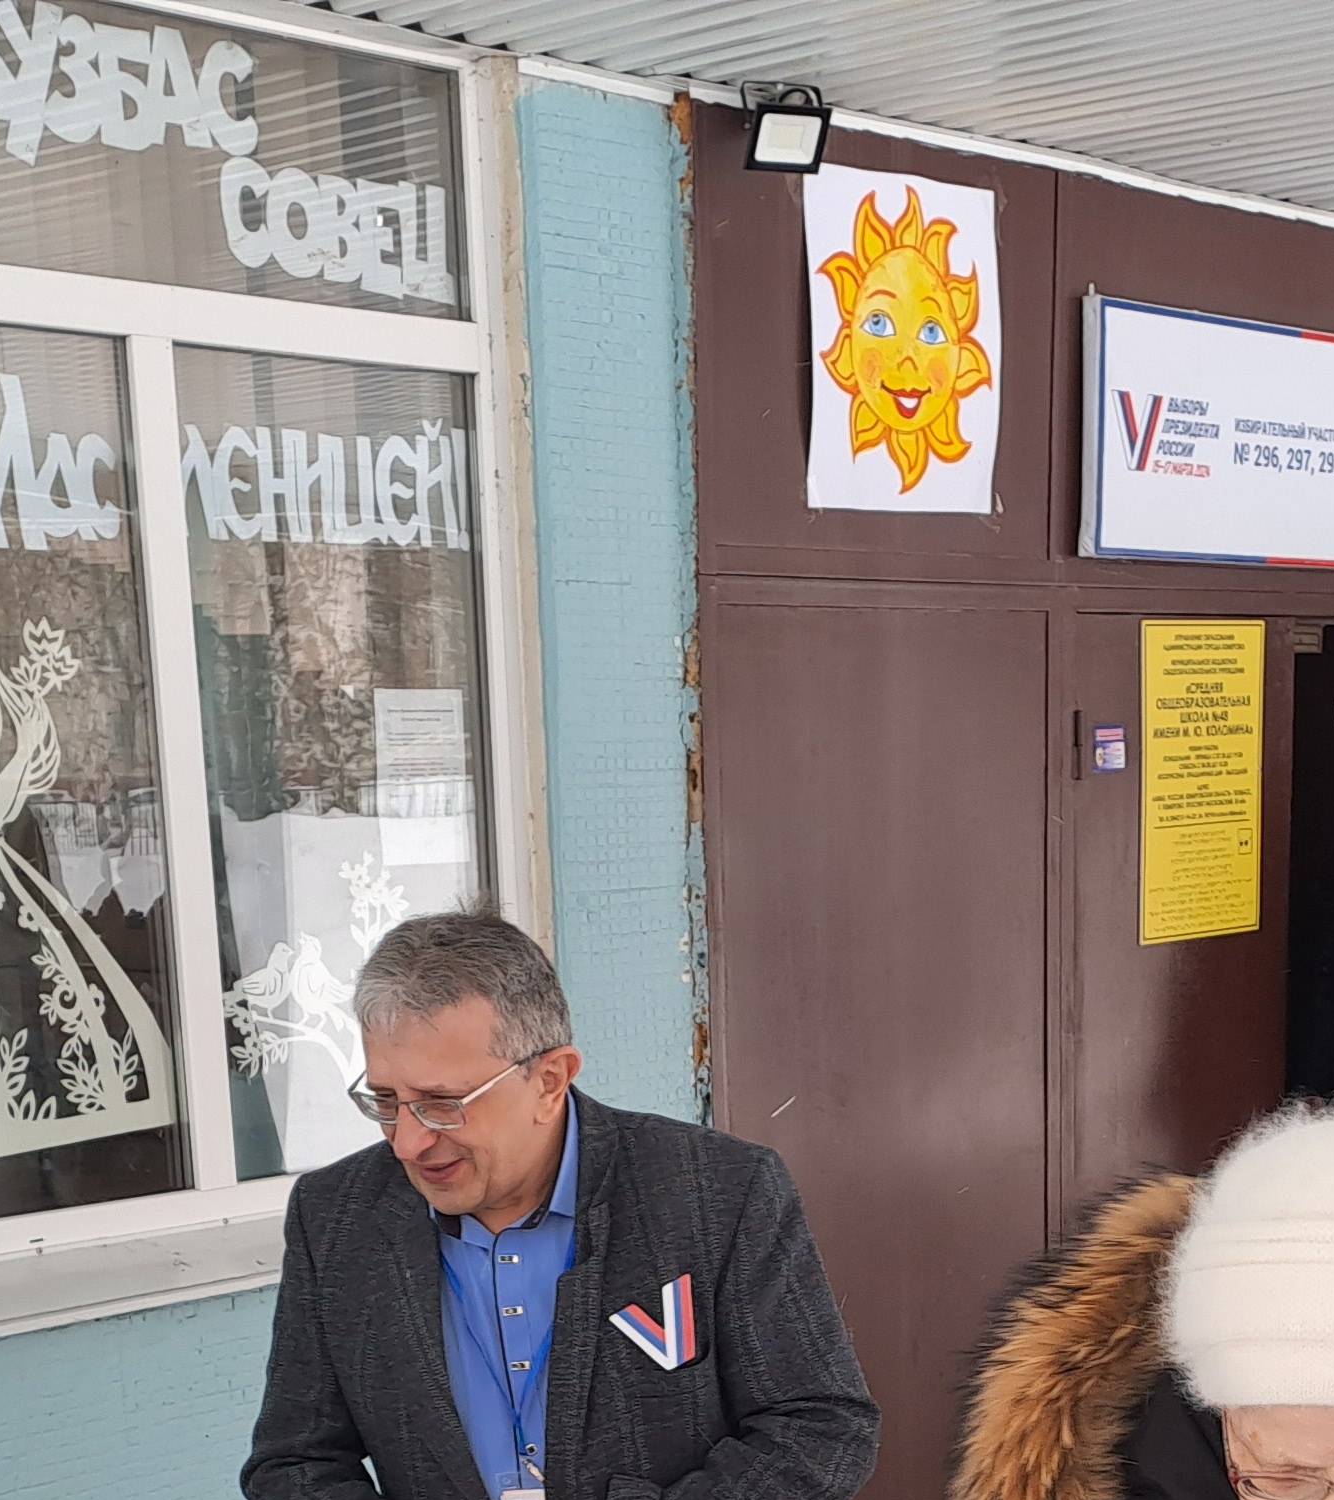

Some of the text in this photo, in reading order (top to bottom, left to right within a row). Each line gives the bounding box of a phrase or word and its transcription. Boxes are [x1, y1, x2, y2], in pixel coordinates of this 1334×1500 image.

[220, 156, 455, 306] СОВЕЦ
[1234, 417, 1306, 440] ИЗБИРАТЕЛЬНЫЙ
[1156, 438, 1196, 458] РОССИИ
[1233, 441, 1250, 466] №
[1253, 444, 1283, 473] 296,
[1286, 447, 1315, 476] 297,
